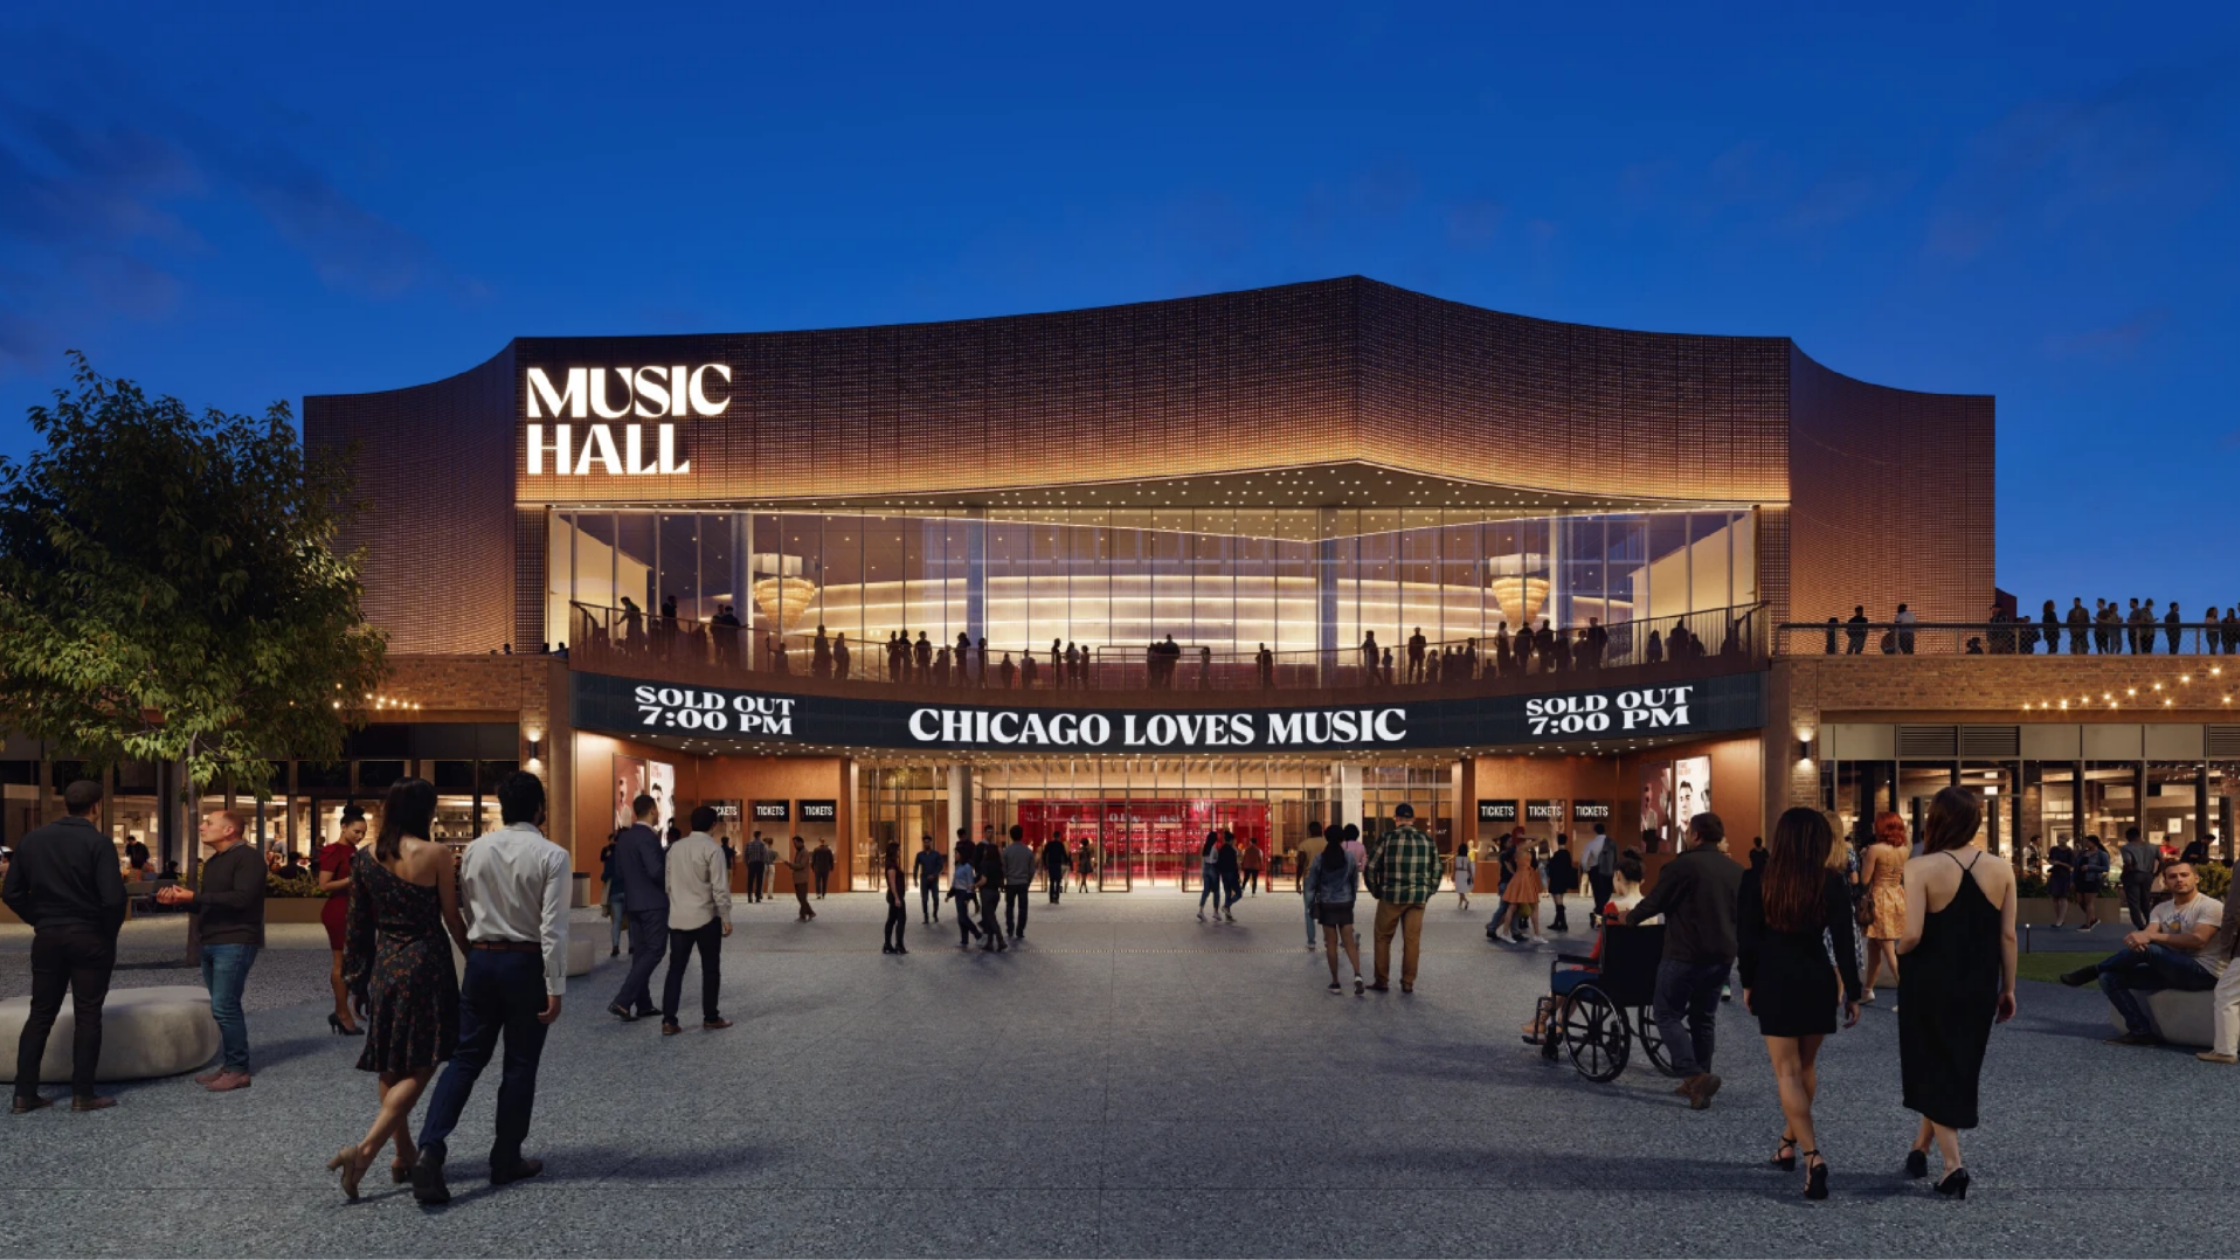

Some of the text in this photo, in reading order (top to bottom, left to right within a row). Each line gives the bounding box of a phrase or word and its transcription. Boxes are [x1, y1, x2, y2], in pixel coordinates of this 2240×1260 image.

[527, 364, 731, 418] MUSIC
[527, 423, 690, 475] HALL
[635, 685, 795, 716] SOLD OUT
[1526, 685, 1693, 716] SOLD OUT
[638, 705, 793, 735] 7:00 PM
[908, 708, 1407, 746] CHICAGO LOVES MUSIC
[1528, 705, 1690, 735] 7:00 PM
[710, 805, 738, 816] CKETS
[756, 805, 785, 816] TICKETS
[804, 805, 833, 816] TICKETS
[1480, 805, 1515, 817] TICKETS
[1528, 805, 1562, 817] TICKETS
[1575, 805, 1609, 817] TICKETS
